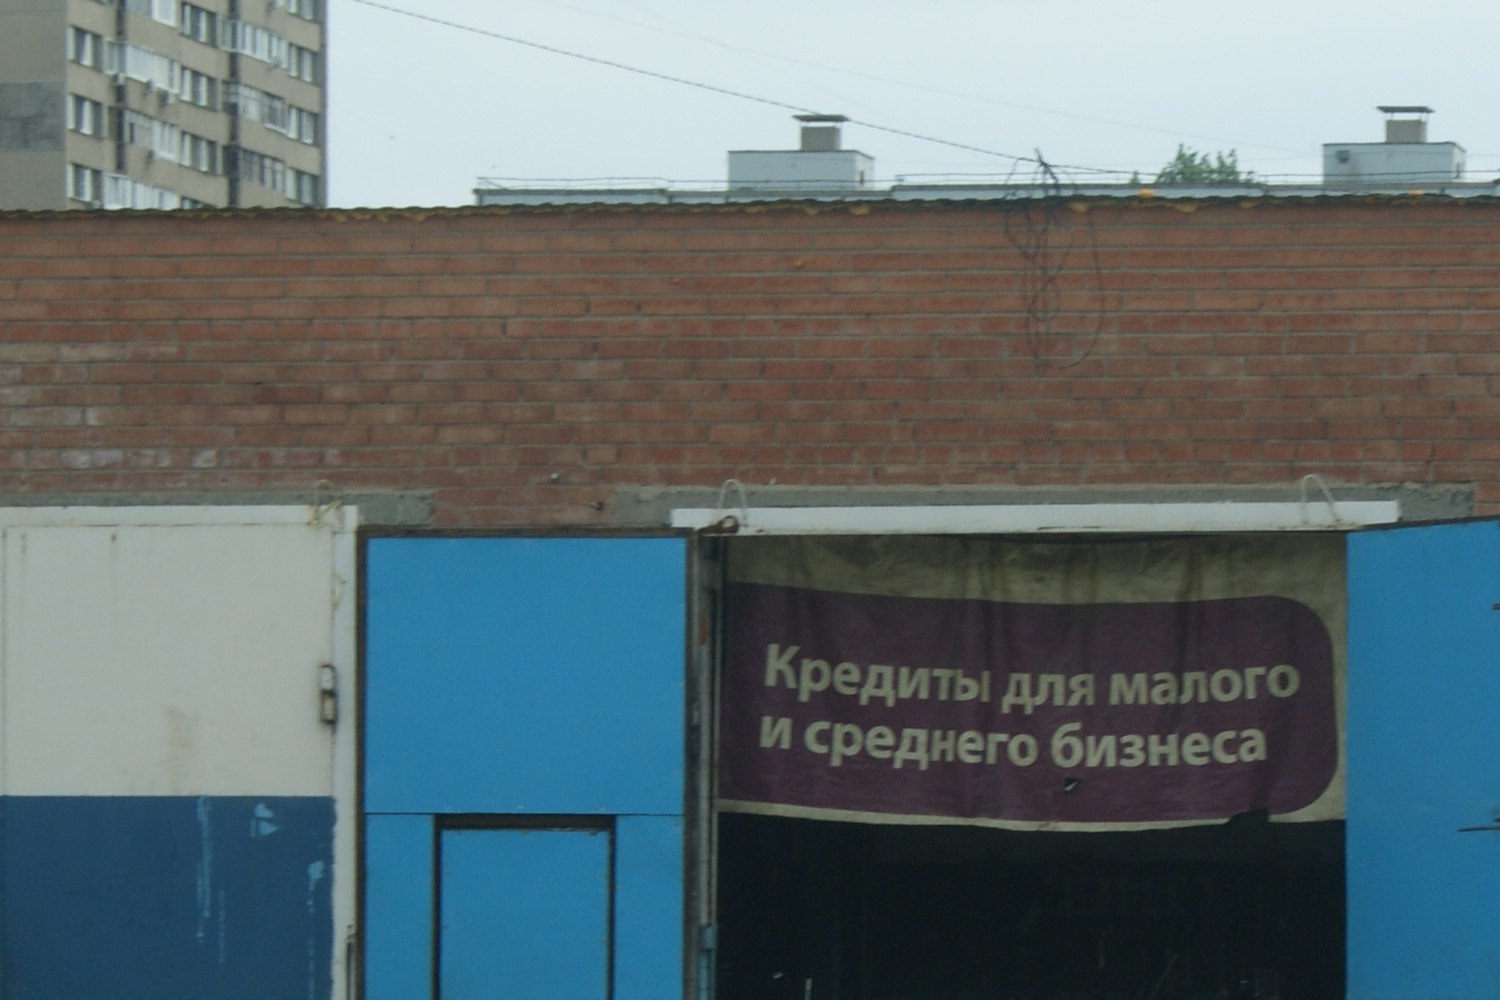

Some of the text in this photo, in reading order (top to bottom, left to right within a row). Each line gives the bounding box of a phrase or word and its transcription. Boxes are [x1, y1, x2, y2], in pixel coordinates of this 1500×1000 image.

[764, 643, 1300, 714] Кредиты для малого
[758, 715, 1267, 770] и среднего бизнеса
